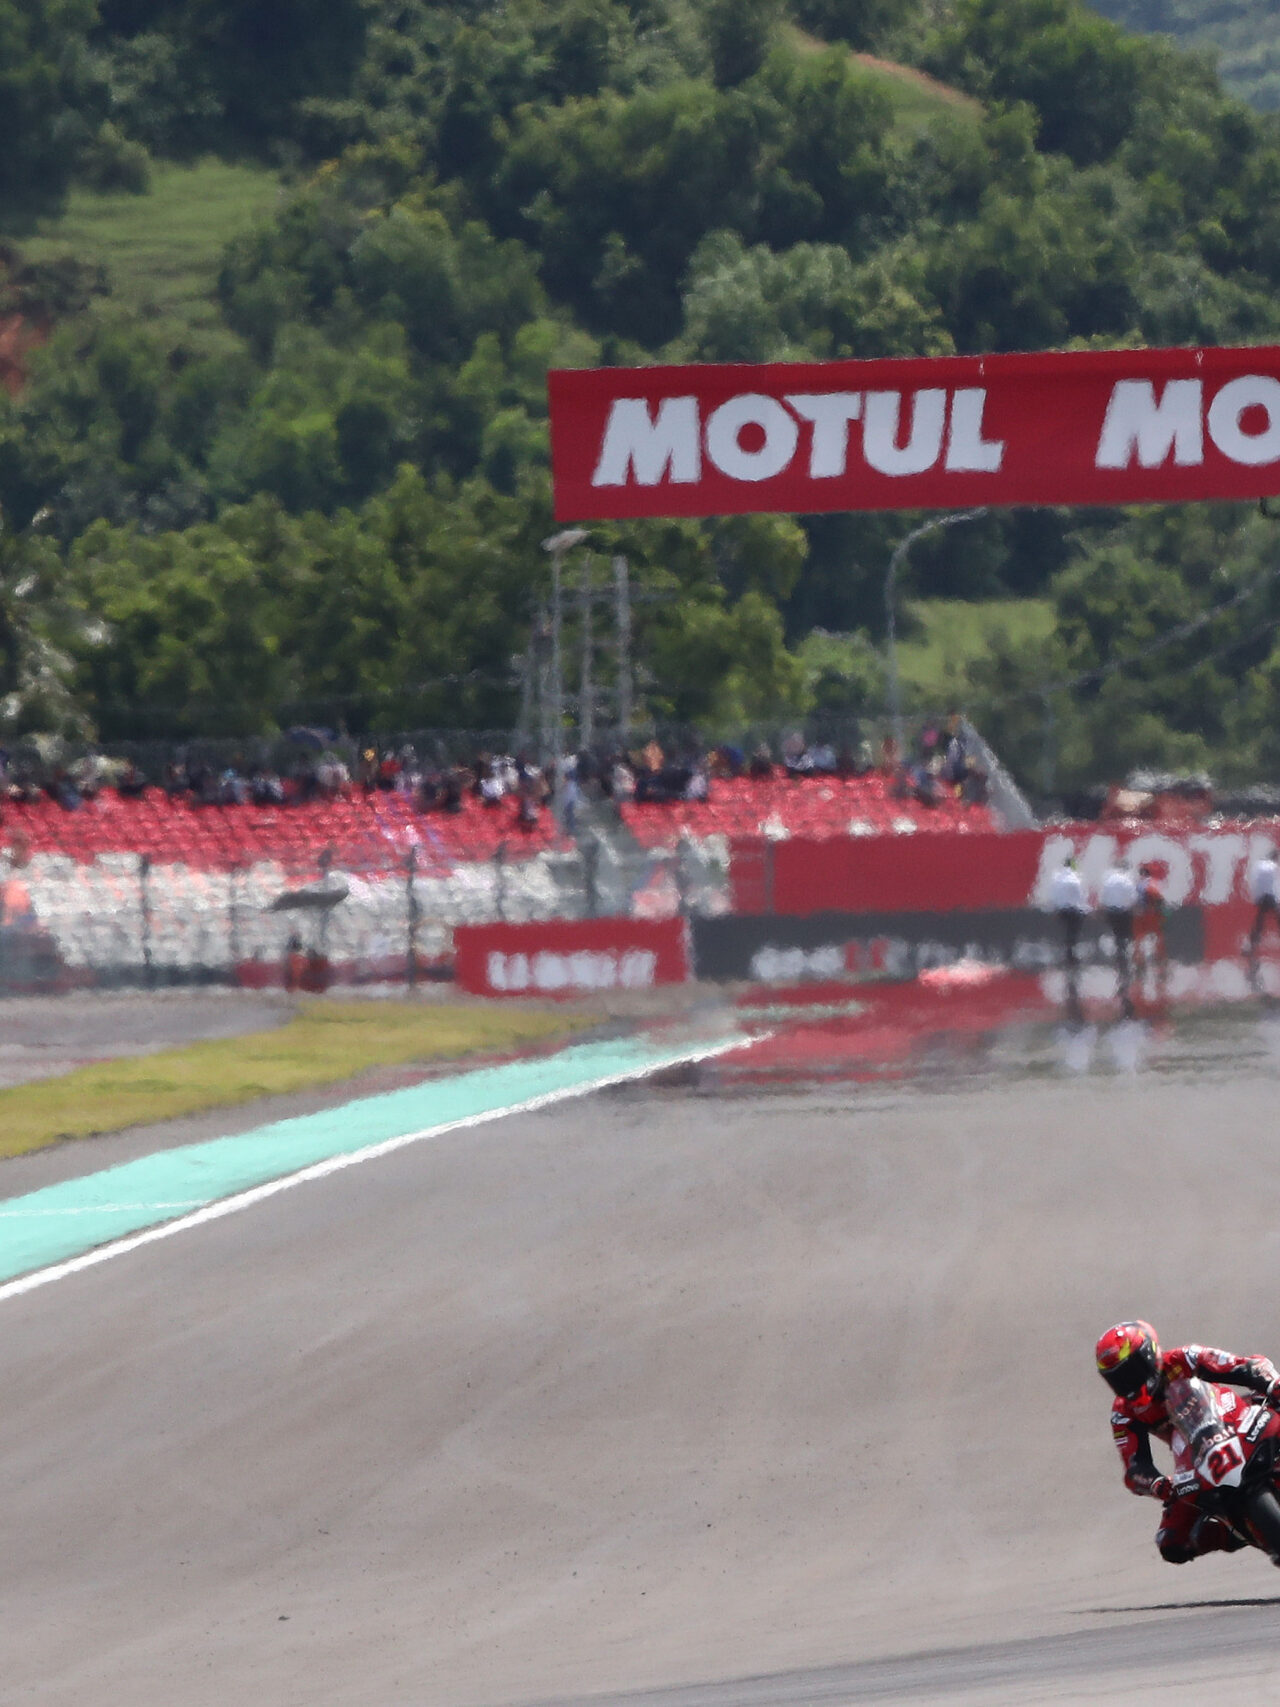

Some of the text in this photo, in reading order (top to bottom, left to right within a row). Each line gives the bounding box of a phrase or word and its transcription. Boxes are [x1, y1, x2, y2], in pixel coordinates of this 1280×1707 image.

[592, 388, 1004, 487] MOTUL
[1245, 1410, 1271, 1441] Lenovo
[1208, 1443, 1243, 1484] 21
